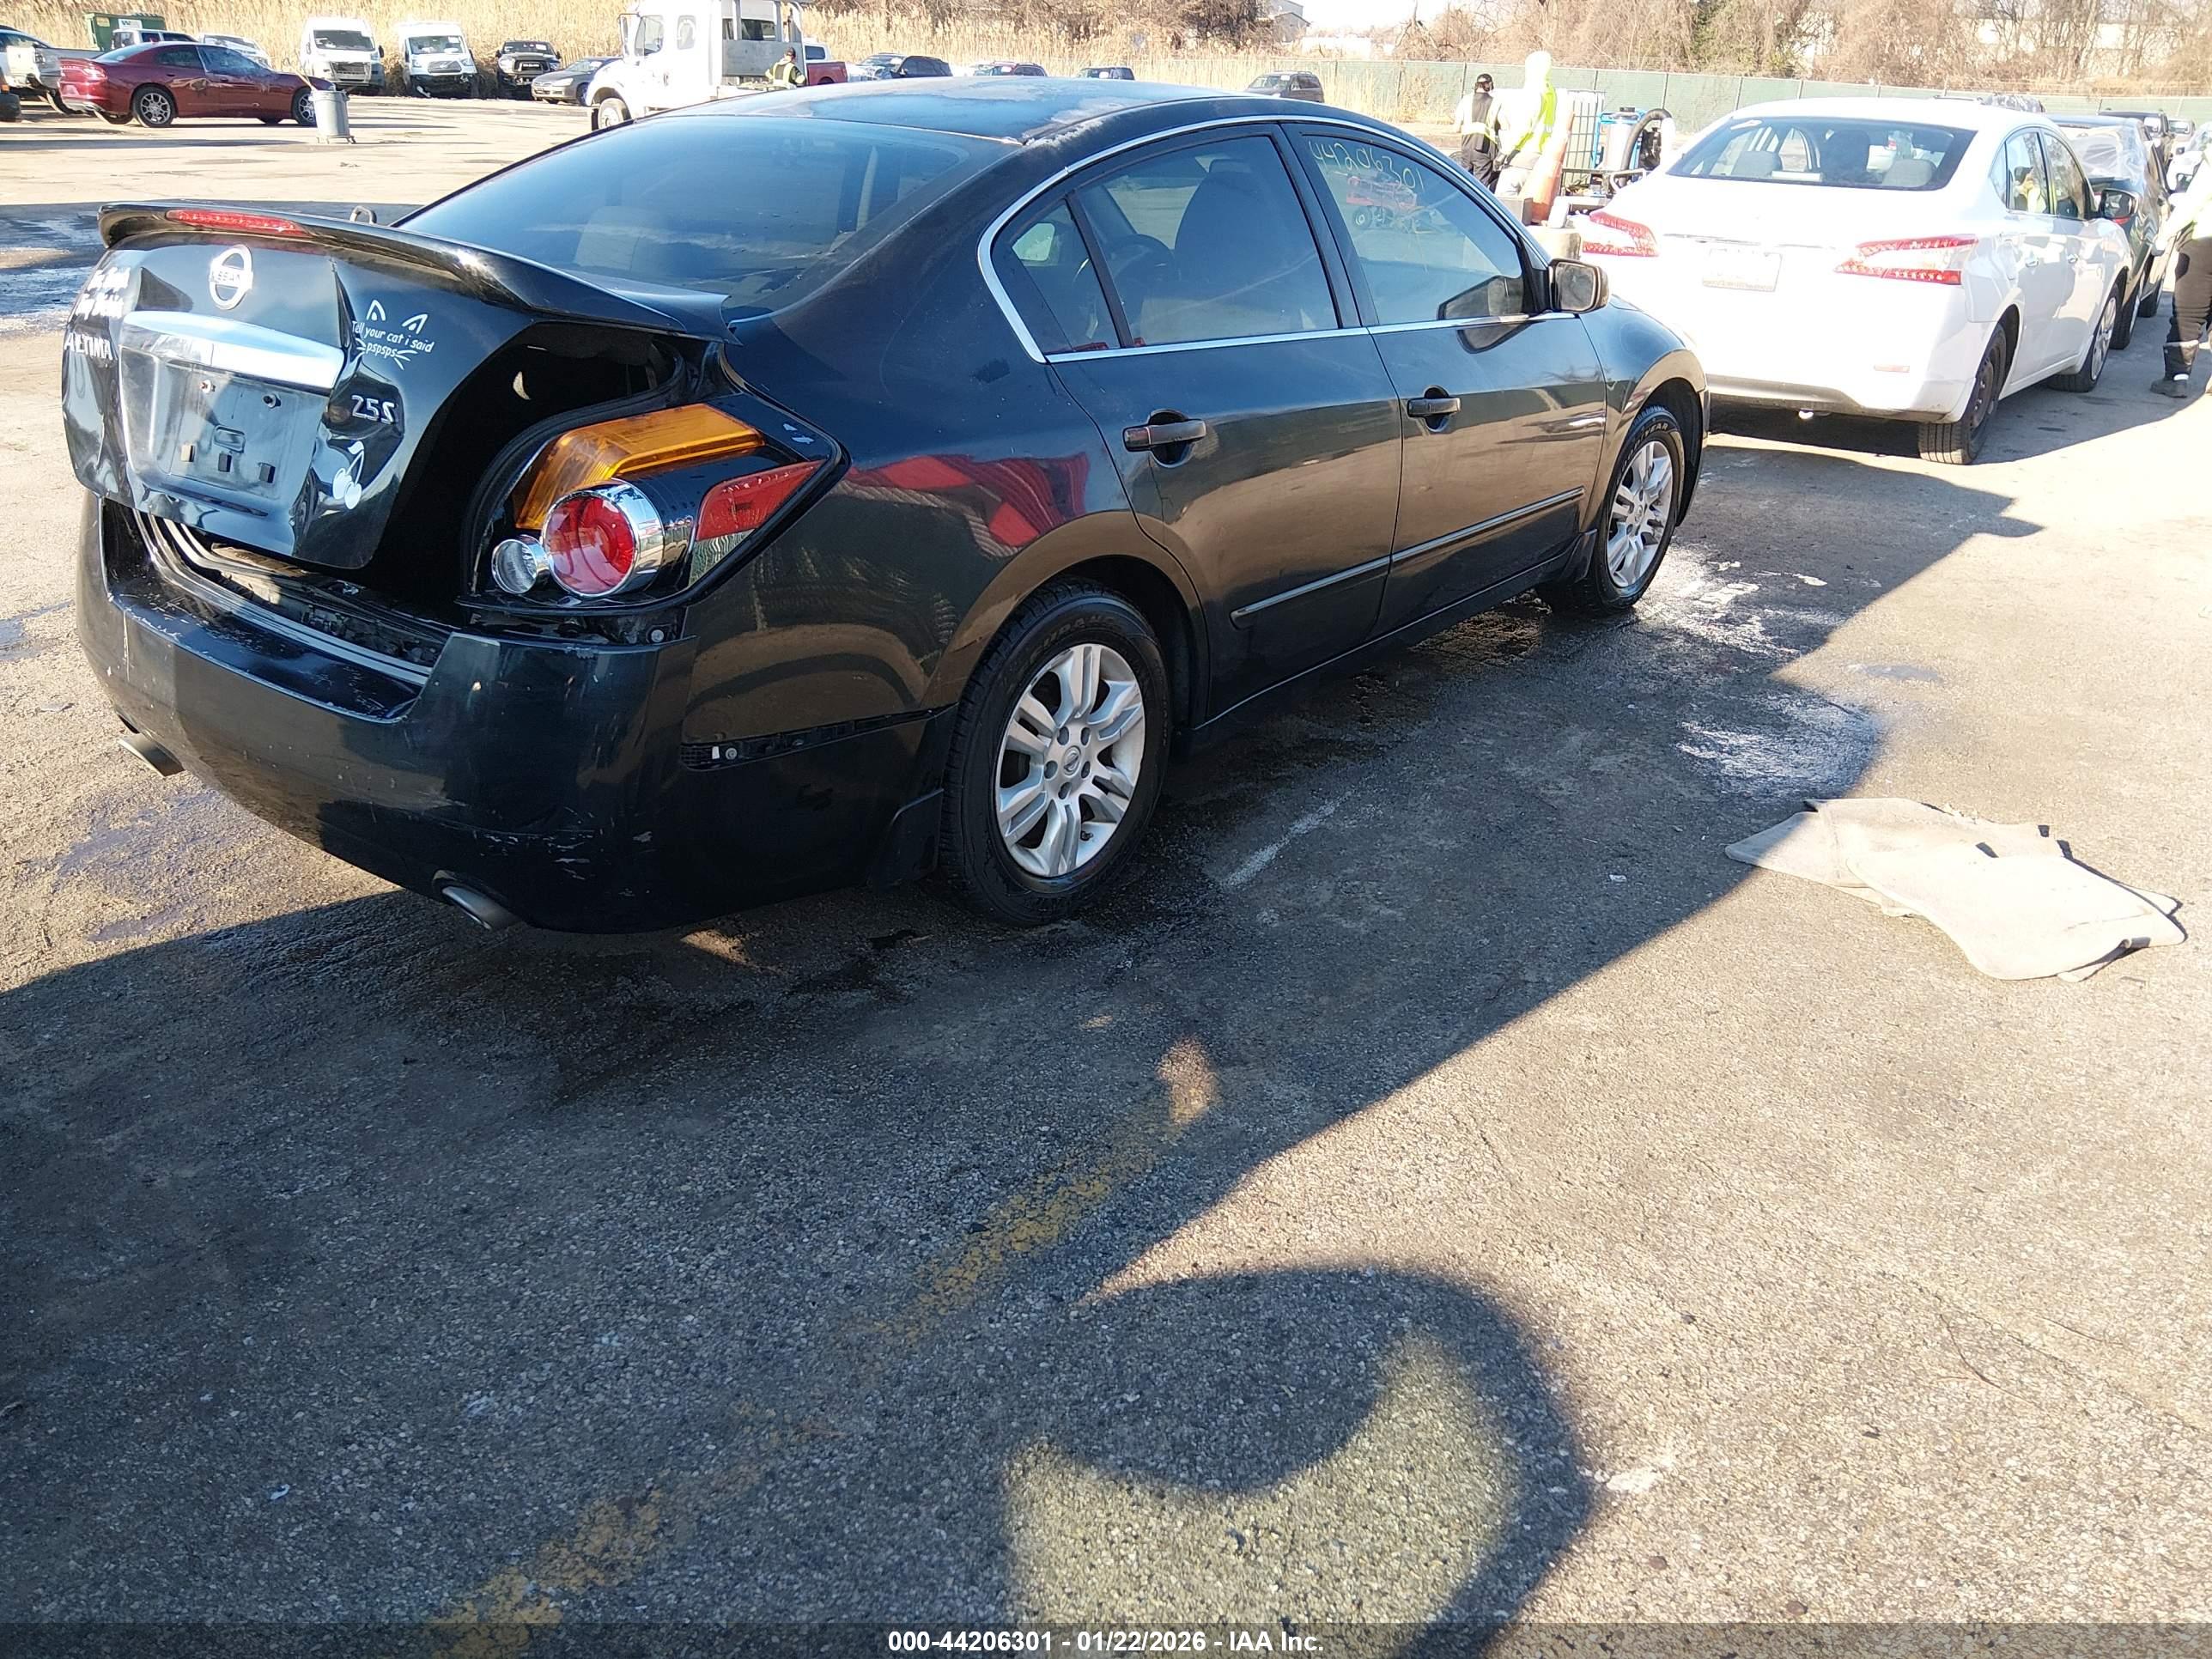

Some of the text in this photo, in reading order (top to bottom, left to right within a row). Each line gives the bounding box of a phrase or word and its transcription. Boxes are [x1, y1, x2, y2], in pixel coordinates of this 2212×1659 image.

[1308, 140, 1425, 192] 44206301
[64, 332, 113, 361] ALTIMA
[352, 320, 365, 334] Tell
[364, 326, 386, 338] your
[386, 332, 404, 343] cat
[410, 339, 435, 353] said
[366, 343, 398, 359] pspsps
